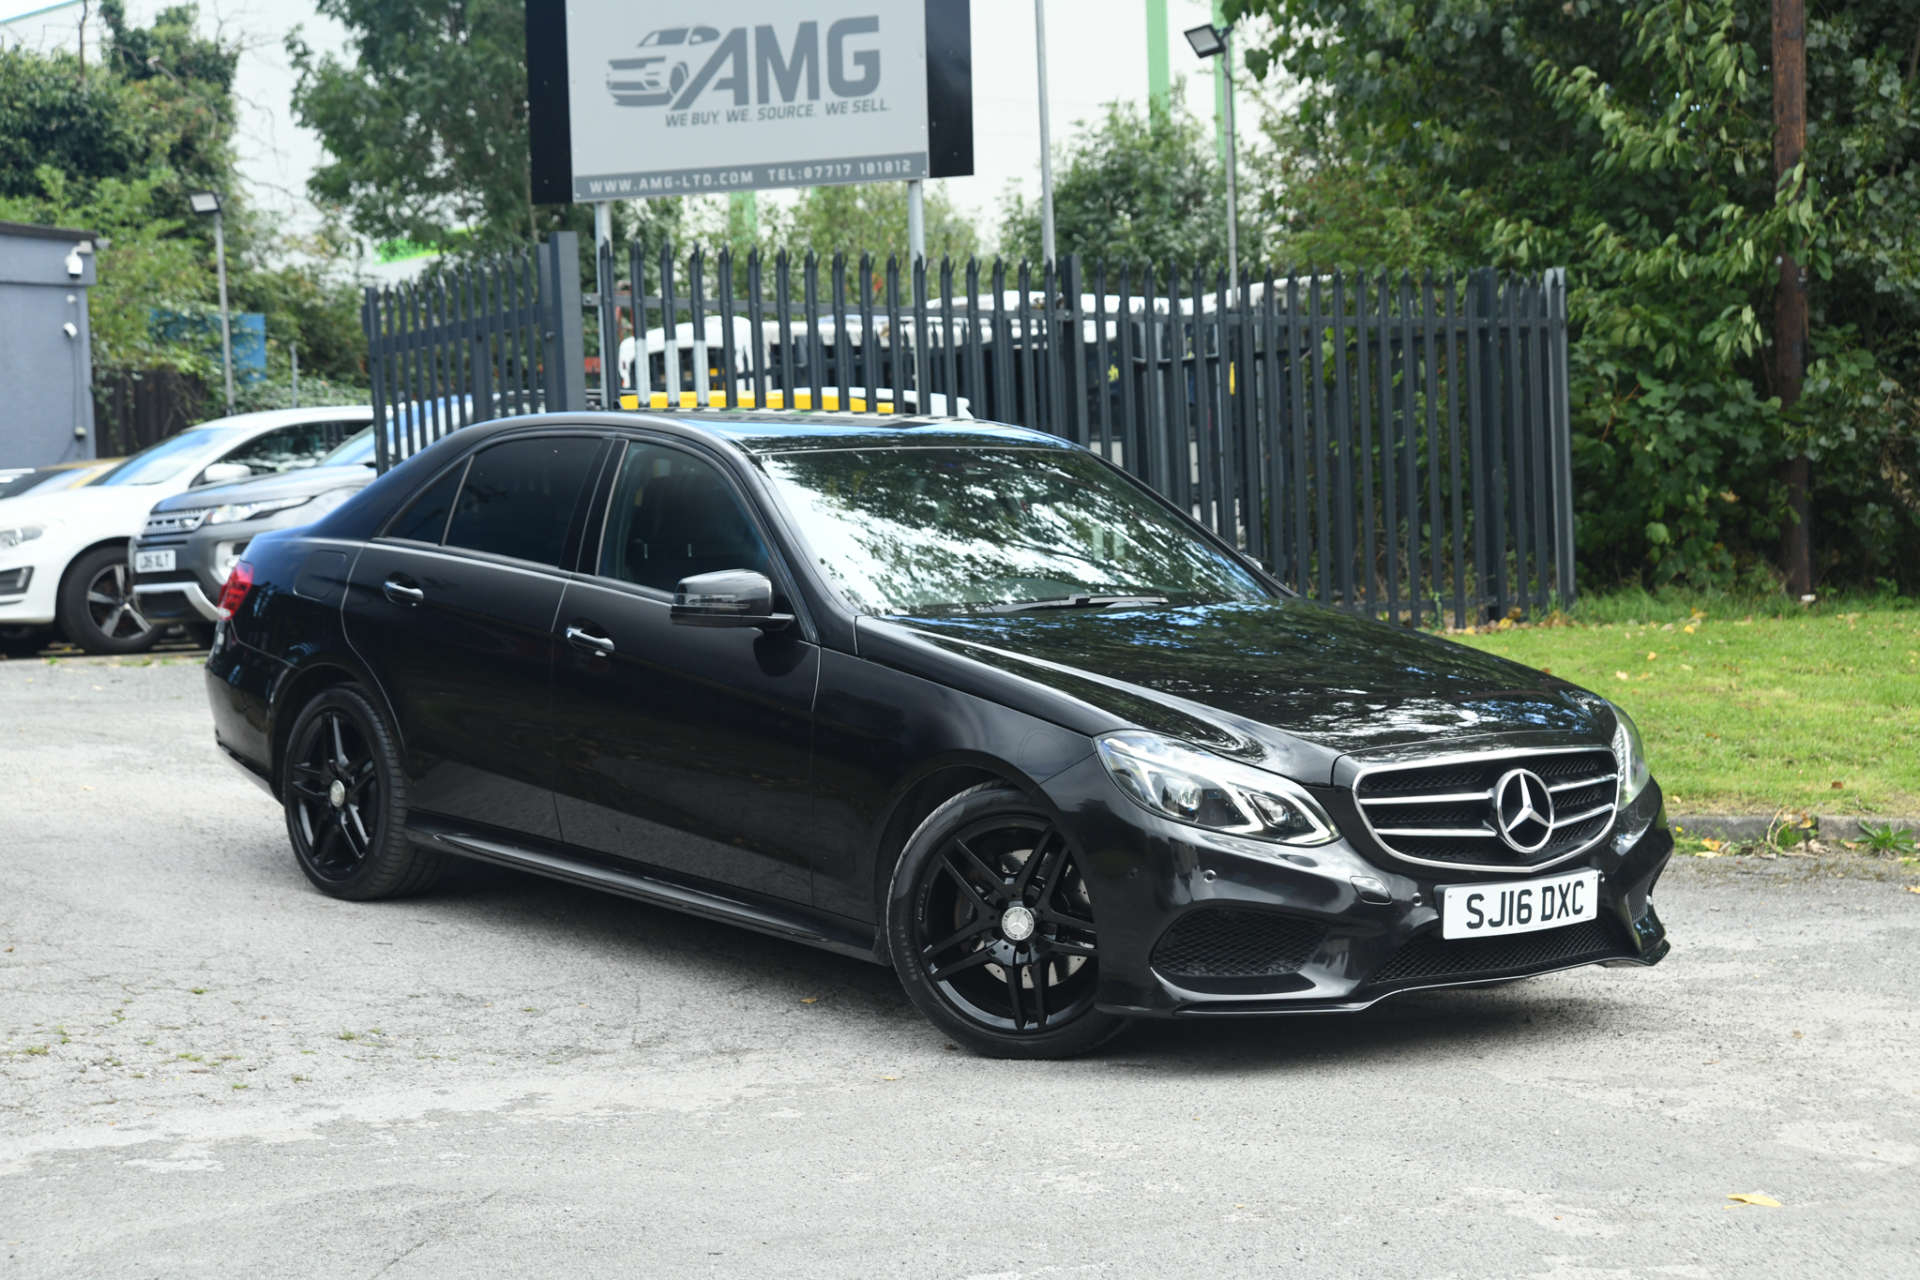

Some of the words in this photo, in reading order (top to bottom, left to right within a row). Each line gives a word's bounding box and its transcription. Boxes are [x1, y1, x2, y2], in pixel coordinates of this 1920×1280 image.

[670, 15, 881, 110] AMG
[665, 112, 688, 127] WE
[825, 101, 848, 116] WE
[852, 98, 891, 114] SELL.
[589, 171, 753, 194] WWW.AMG-LTD.COM
[1466, 889, 1531, 929] SJ16
[1540, 880, 1584, 921] DXC
